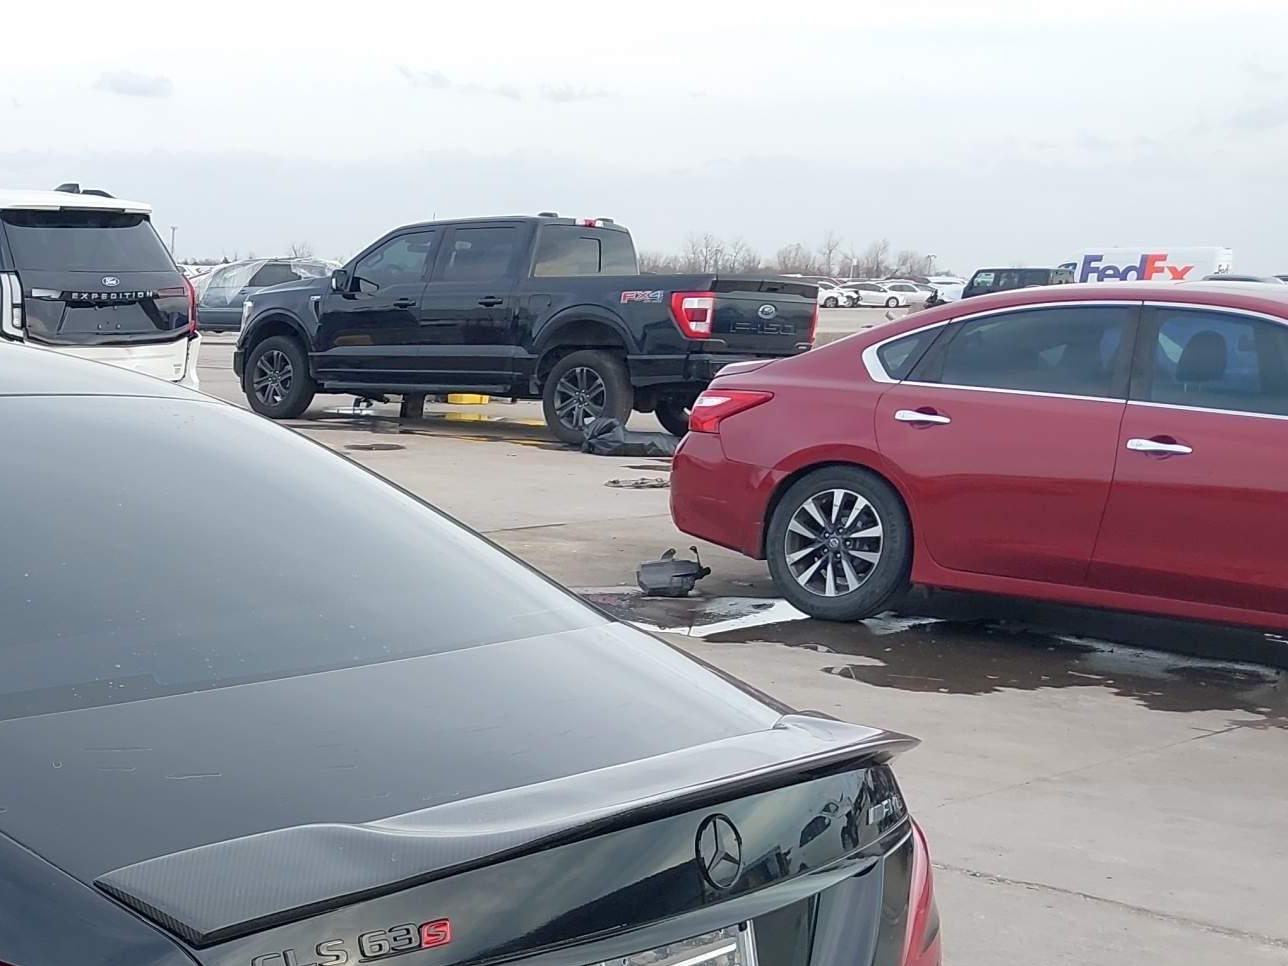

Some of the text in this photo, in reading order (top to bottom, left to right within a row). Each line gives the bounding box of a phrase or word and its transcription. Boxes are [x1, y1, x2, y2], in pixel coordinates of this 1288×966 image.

[1079, 254, 1194, 282] FedEx
[72, 291, 153, 300] EXPEDITION
[620, 291, 664, 303] FX4
[730, 320, 796, 336] F-150
